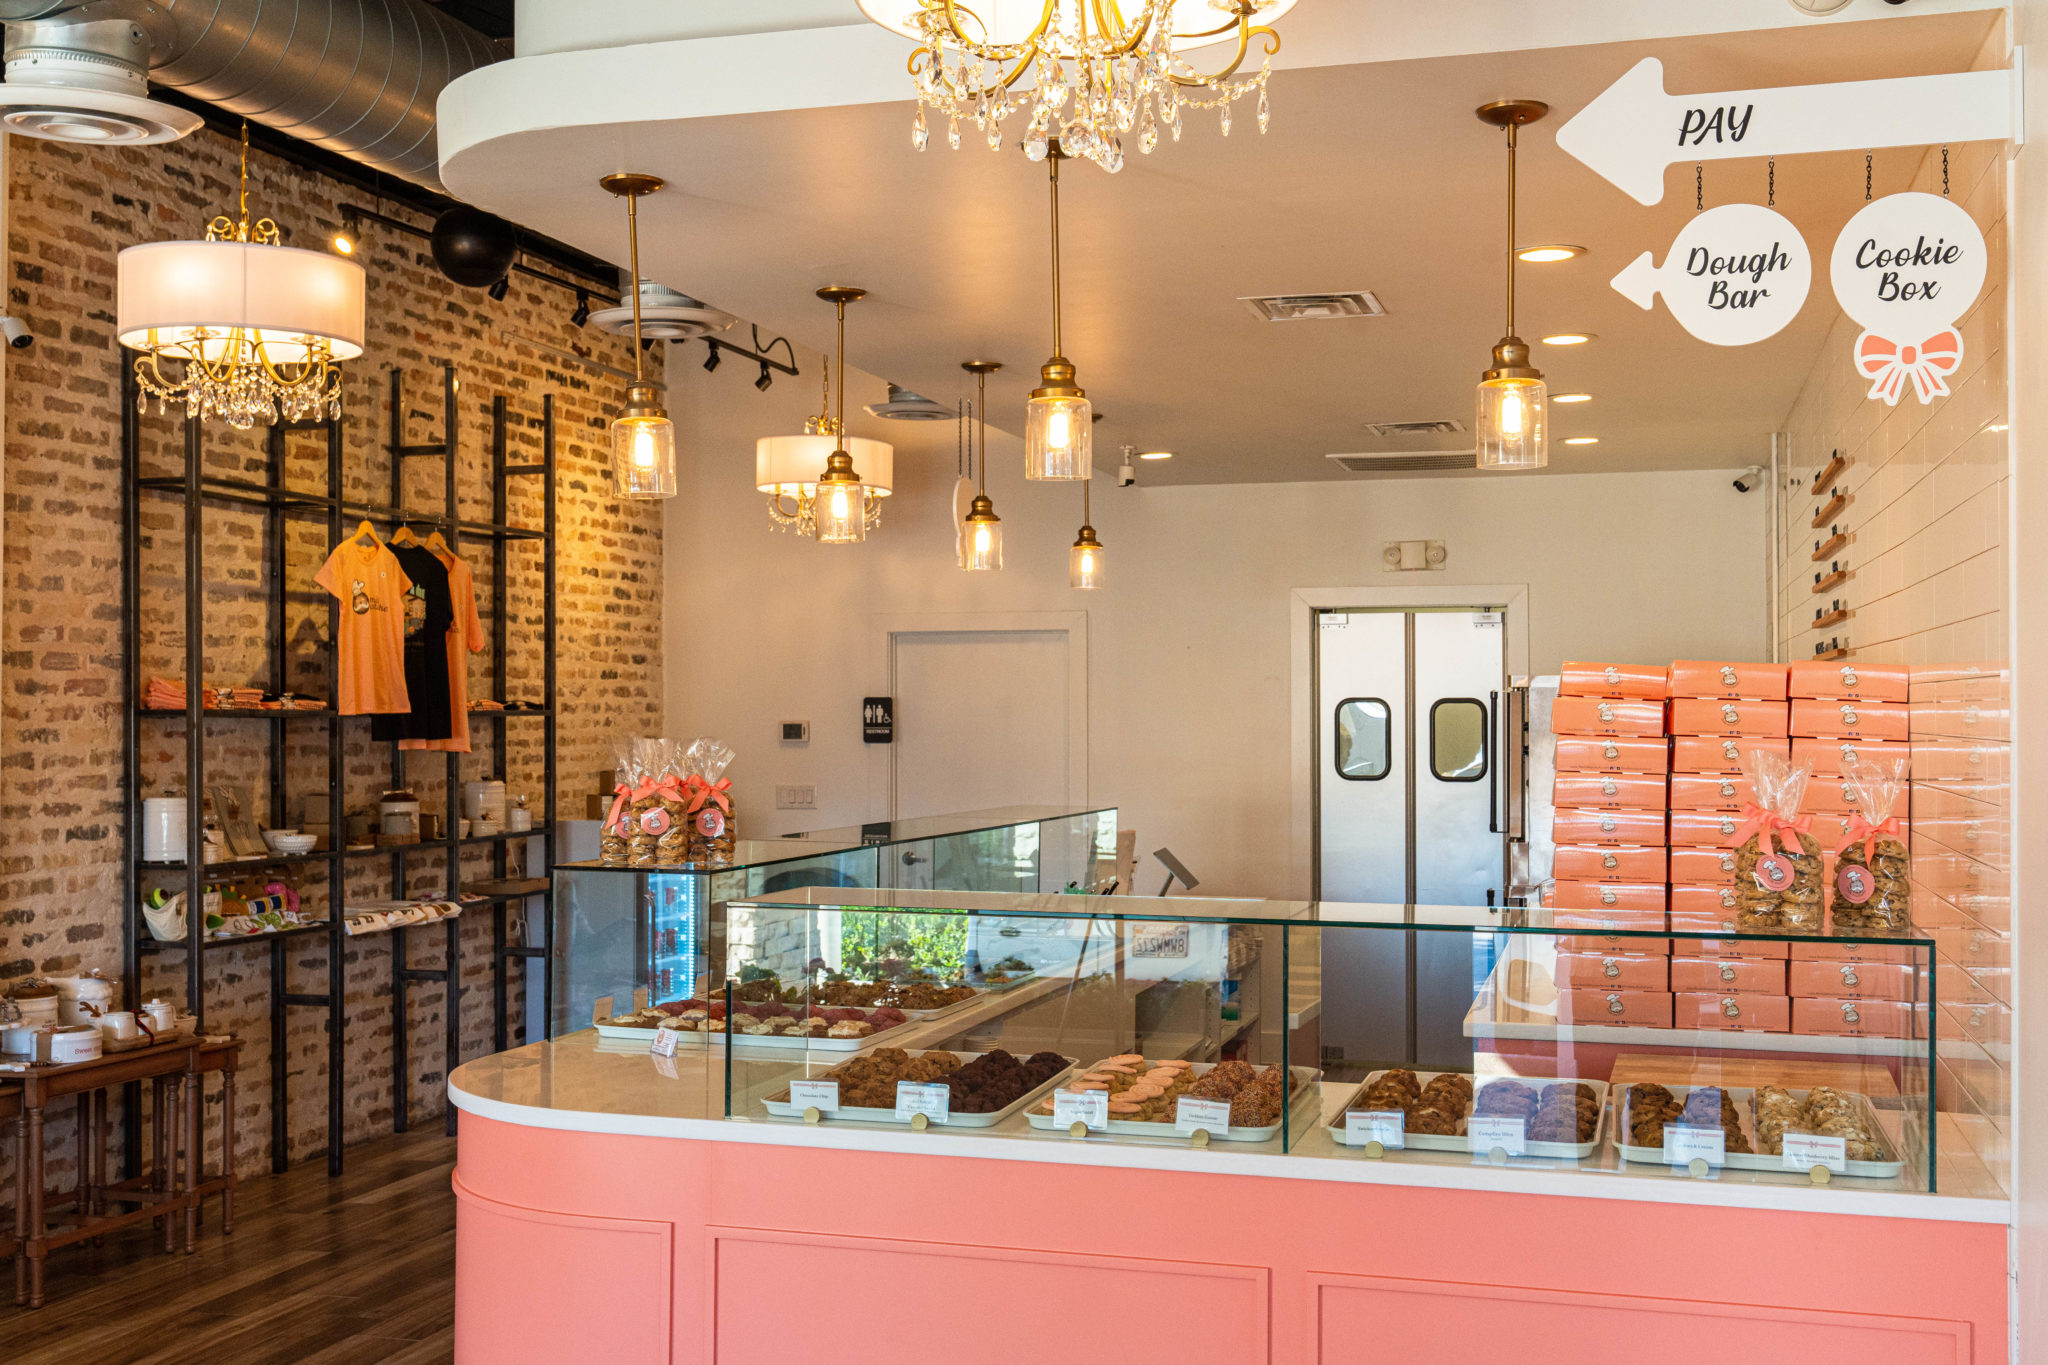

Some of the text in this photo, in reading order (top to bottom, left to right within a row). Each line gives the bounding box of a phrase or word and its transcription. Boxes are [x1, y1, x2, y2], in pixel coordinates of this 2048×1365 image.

[1678, 104, 1754, 146] PAY
[1686, 241, 1792, 285] Dough
[1855, 235, 1964, 270] Cookie
[1707, 280, 1771, 310] Bar
[1877, 271, 1941, 301] Box
